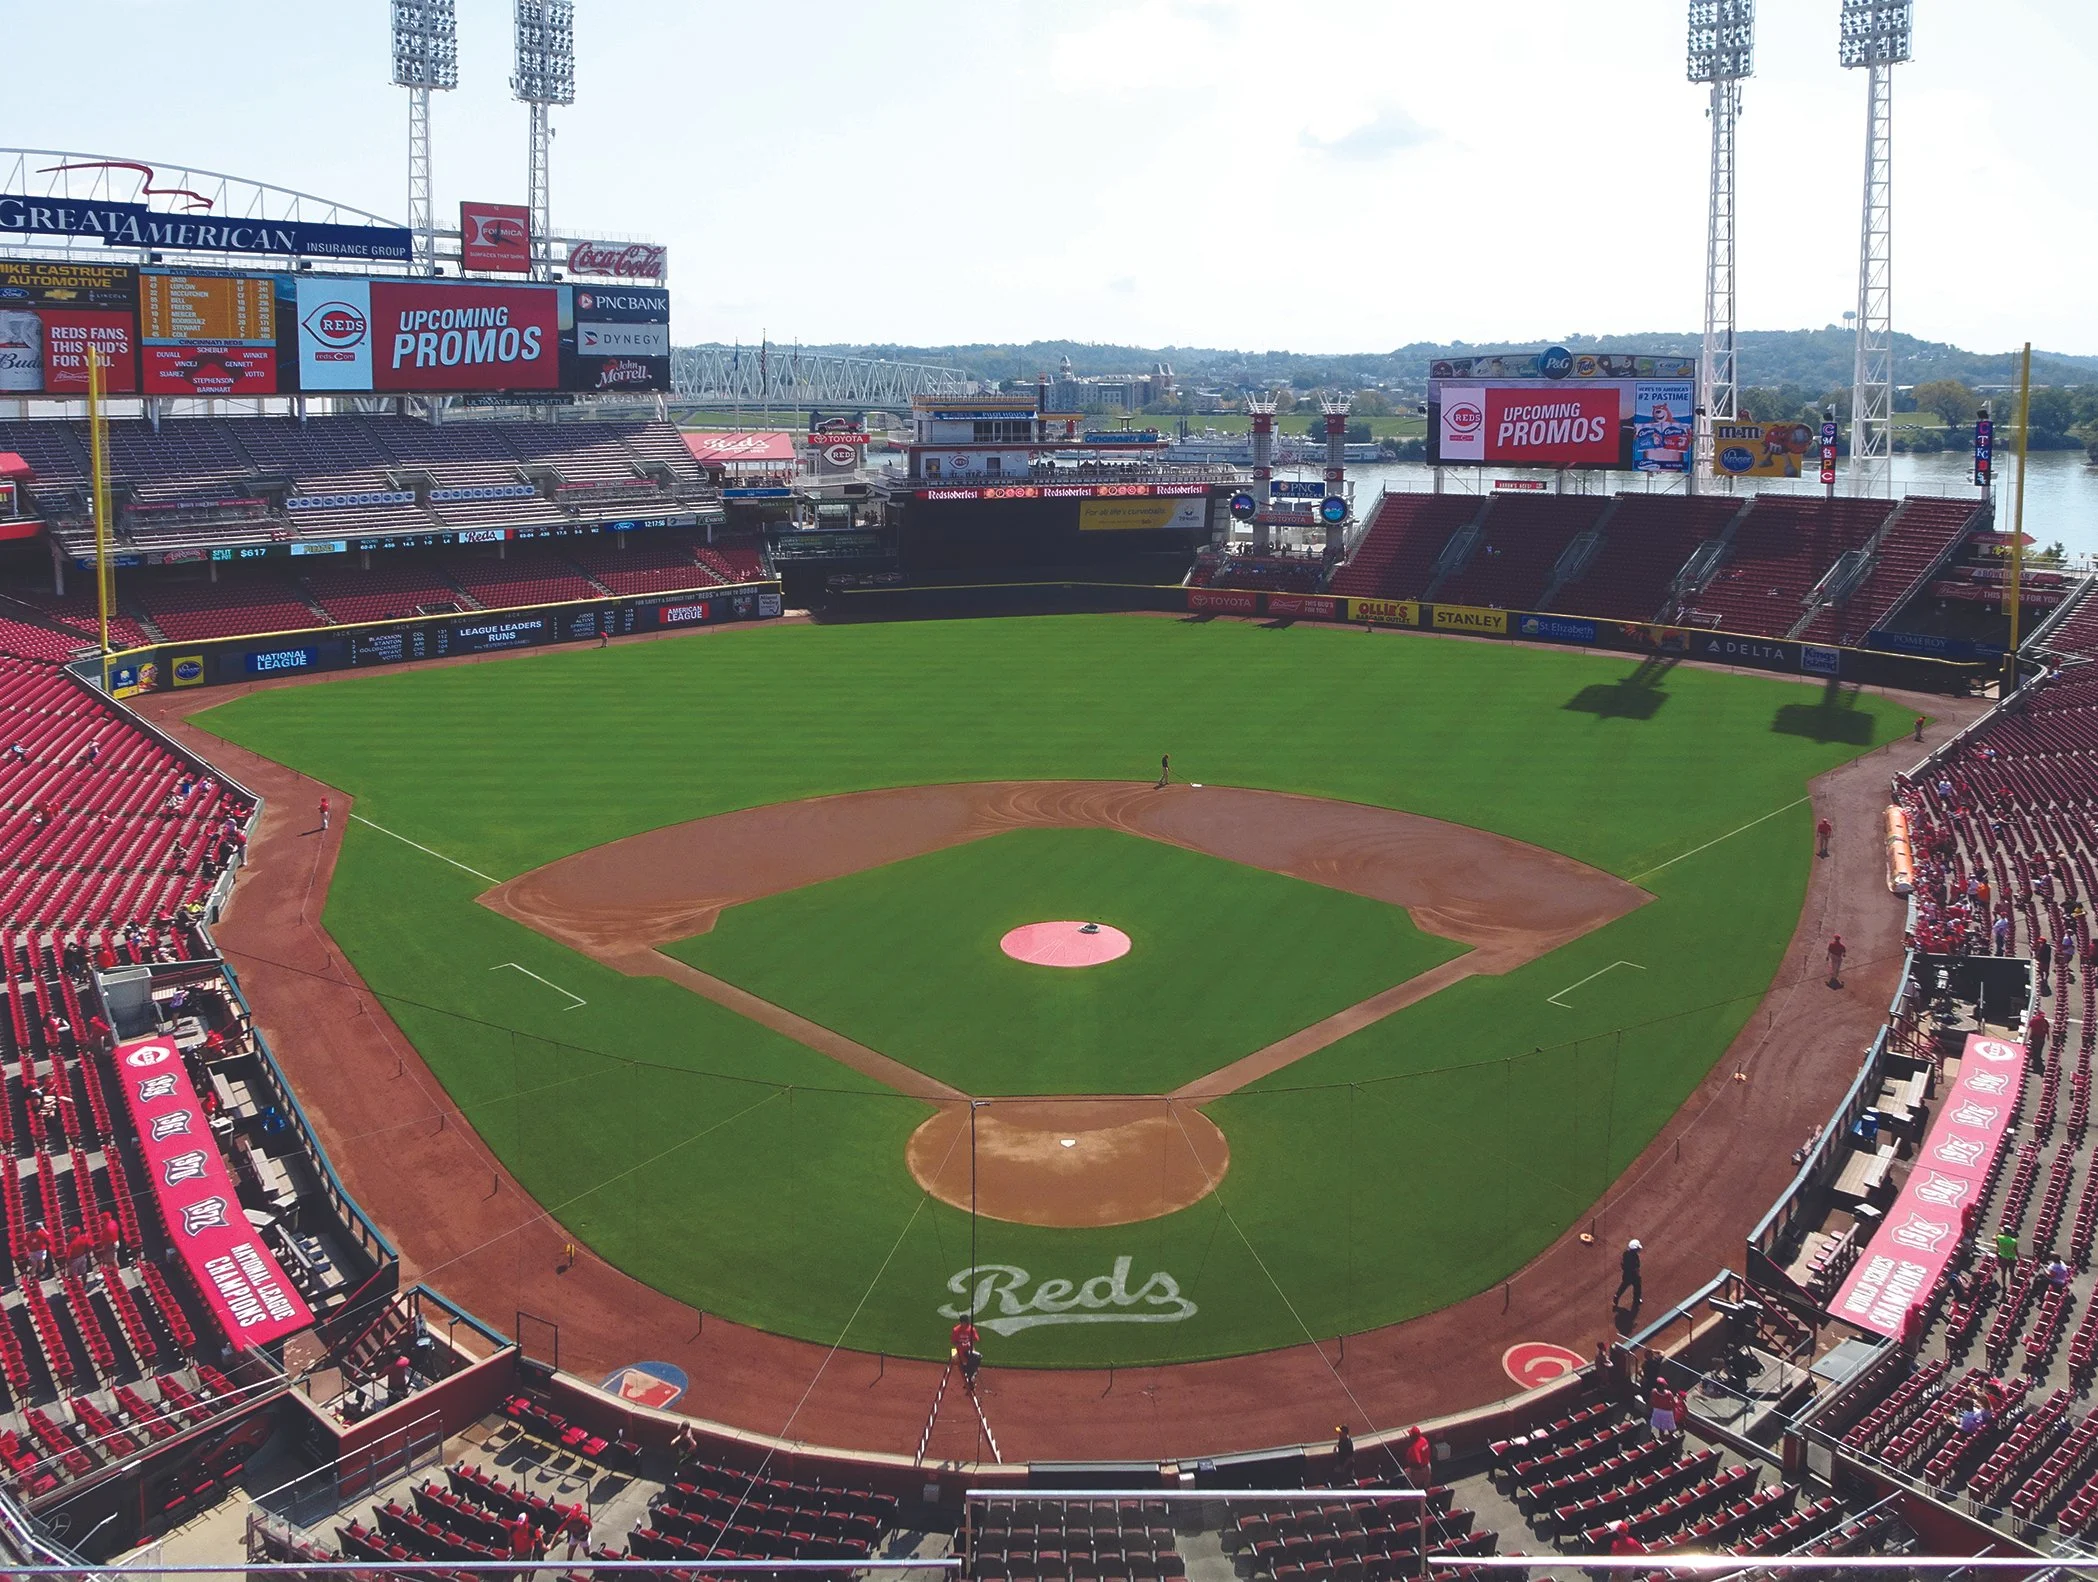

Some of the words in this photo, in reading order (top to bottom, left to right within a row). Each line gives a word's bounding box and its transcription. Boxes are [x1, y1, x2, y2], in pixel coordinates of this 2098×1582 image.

[0, 199, 124, 233] GREAT
[114, 215, 296, 250] AMERICAN
[306, 242, 368, 255] INSURANCE
[371, 246, 406, 257] GROUP
[568, 241, 666, 278] Coca-Cola
[36, 265, 128, 277] CASTRUCCI
[8, 275, 112, 287] AUTOMOTIVE
[322, 319, 364, 332] REDS
[399, 306, 508, 332] UPCOMING
[51, 327, 88, 339] REDS
[604, 335, 660, 345] DYNEGY
[51, 341, 84, 353] THIS
[392, 326, 541, 369] PROMOS
[52, 355, 80, 367] FOR
[615, 359, 638, 372] John
[1546, 357, 1570, 369] P&G
[595, 366, 652, 388] Morrell
[1638, 393, 1649, 401] #2
[1651, 393, 1689, 401] PASTIME
[1455, 413, 1480, 422] REDS
[1503, 402, 1581, 421] UPCOMING
[1497, 416, 1606, 447] PROMOS
[703, 436, 770, 452] Reds
[828, 434, 863, 443] TOYOTA
[832, 451, 856, 459] REDS
[1723, 449, 1752, 466] Kroger
[928, 489, 978, 499] Redstoberfest
[1044, 488, 1092, 497] Redstoberfest
[1156, 485, 1203, 495] Redstoberfest
[1291, 483, 1316, 493] PNC
[465, 531, 498, 542] Reds
[240, 549, 267, 557] $617
[1209, 596, 1251, 607] TOYOTA
[1984, 591, 2000, 599] THIS
[2026, 594, 2042, 602] FOR
[668, 606, 702, 615] AMERICAN
[1358, 602, 1408, 618] OLLIE'S
[667, 612, 702, 622] LEAGUE
[1437, 611, 1502, 628] STANLEY
[460, 625, 498, 637] LEAGUE
[500, 620, 542, 633] LEADERS
[1551, 622, 1594, 635] Elizabeth
[368, 634, 402, 642] BLACKMON
[488, 632, 516, 642] RUNS
[1893, 634, 1948, 648] POMEROY
[257, 650, 307, 662] NATIONAL
[1726, 641, 1785, 660] DELTA
[1803, 647, 1837, 661] Kings
[257, 657, 307, 670] LEAGUE
[1803, 658, 1837, 673] Island
[187, 1197, 226, 1230] 1972
[1901, 1219, 1944, 1250] 1919
[231, 1242, 268, 1286] NATIONAL
[257, 1281, 297, 1322] LEAGUE
[1844, 1280, 1877, 1315] WORLD
[1862, 1254, 1896, 1285] SERIES
[204, 1256, 268, 1328] CHAMPIONS
[937, 1255, 1199, 1336] Reds
[1868, 1260, 1928, 1329] CHAMPIONS
